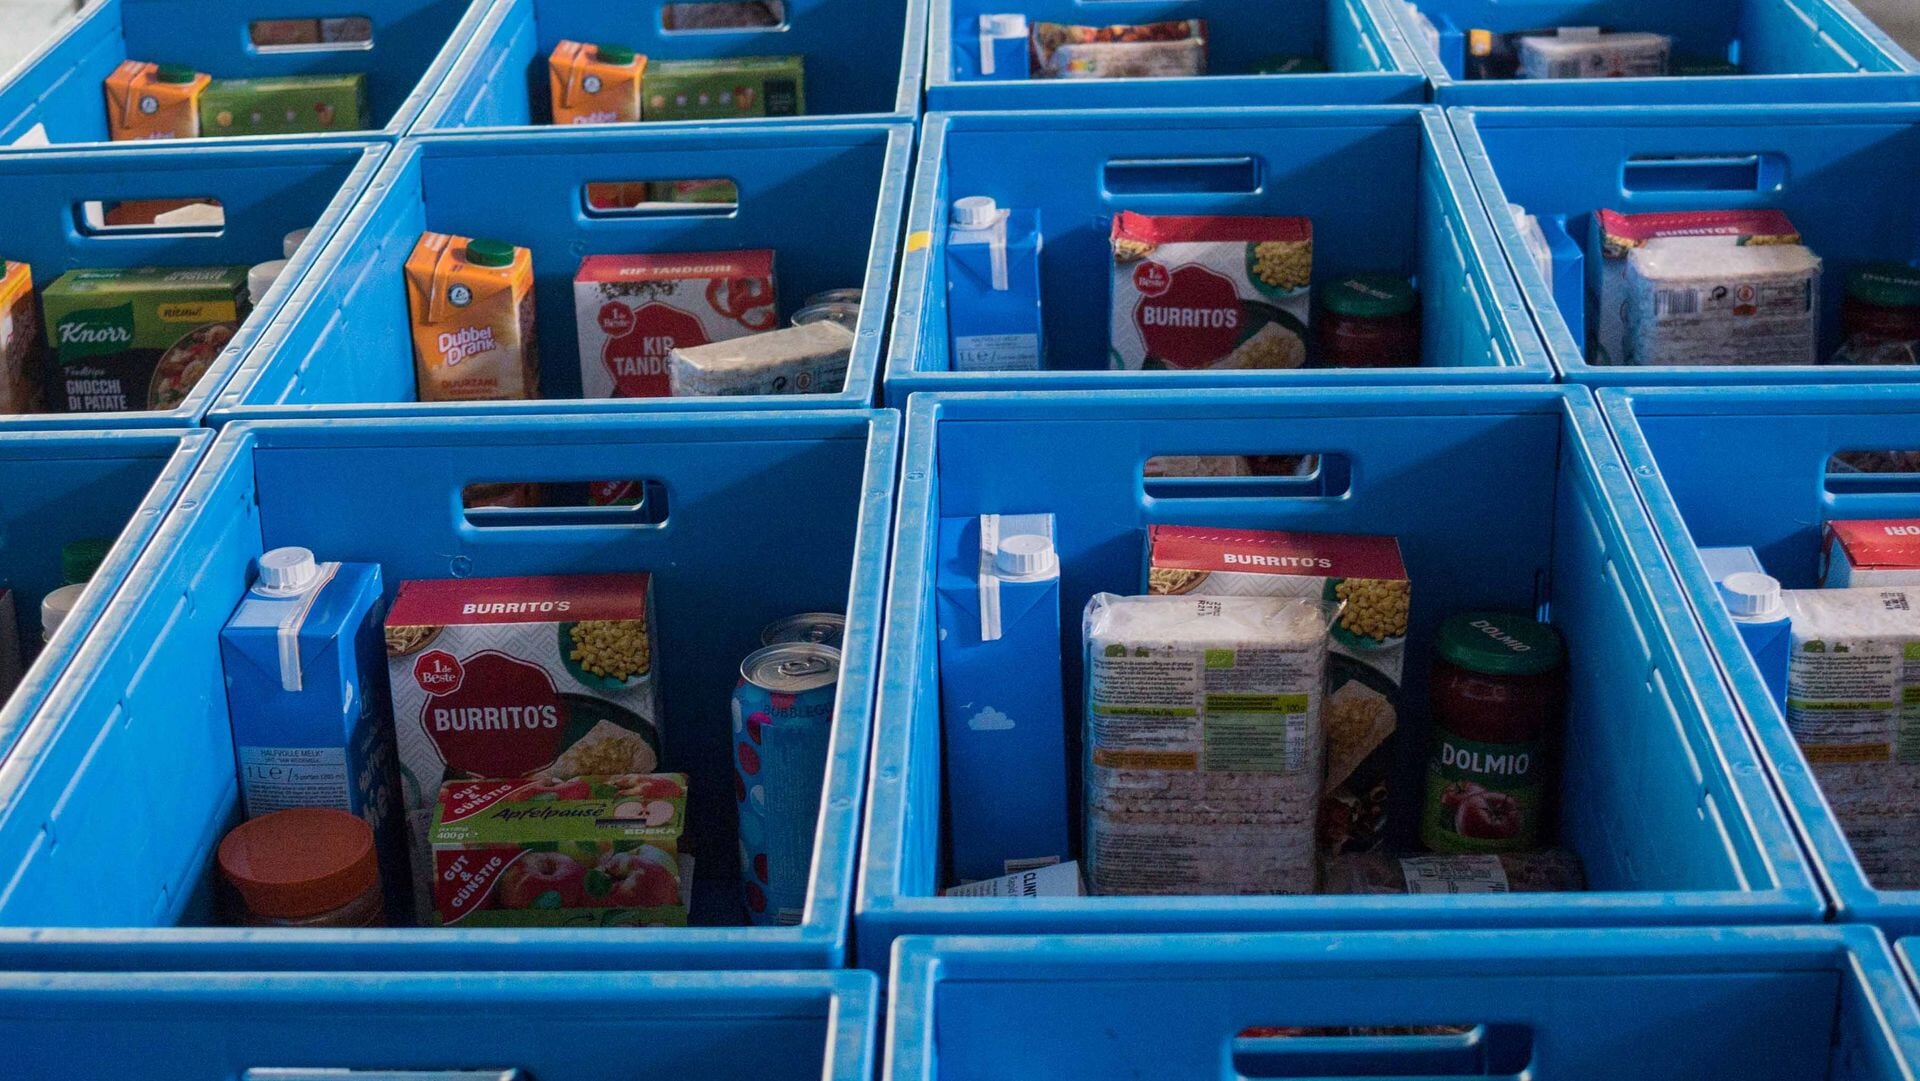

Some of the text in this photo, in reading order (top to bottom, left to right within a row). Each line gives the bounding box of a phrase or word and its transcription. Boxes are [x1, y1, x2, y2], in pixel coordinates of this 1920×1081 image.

[619, 264, 732, 276] KIP TANDOORI
[1143, 306, 1238, 329] BURRITO'S
[58, 322, 132, 343] Knorr
[438, 327, 492, 353] Dubbel
[447, 338, 497, 366] Drank
[643, 335, 675, 356] KIP
[614, 356, 673, 377] TANDO
[66, 379, 121, 395] GNOCCHI
[68, 395, 128, 411] DI PATATE
[1224, 553, 1332, 569] BURRITO'S
[462, 600, 571, 615] BURRITO'S
[1469, 619, 1531, 652] DOLMIO
[432, 660, 442, 673] 1
[422, 672, 457, 684] Beste
[434, 705, 558, 732] BURRITO'S
[1441, 742, 1530, 775] DOLMIO
[452, 783, 480, 800] GUT
[453, 783, 513, 815] GÜNSTIG
[491, 805, 607, 821] Apfelpause
[436, 832, 457, 840] 400
[443, 855, 469, 881] GUT
[461, 871, 473, 882] &
[451, 855, 503, 908] GÜNSTIG
